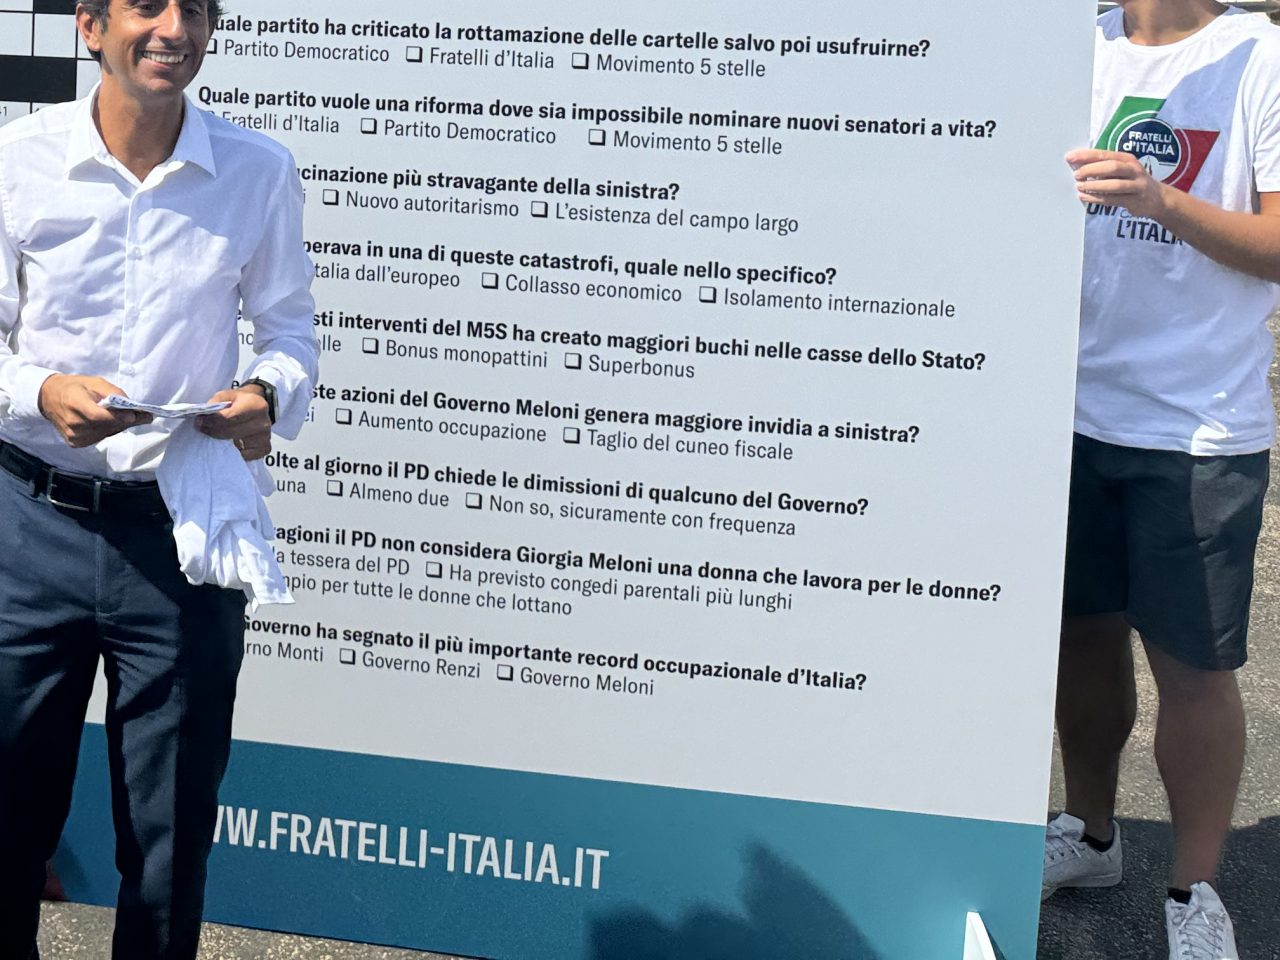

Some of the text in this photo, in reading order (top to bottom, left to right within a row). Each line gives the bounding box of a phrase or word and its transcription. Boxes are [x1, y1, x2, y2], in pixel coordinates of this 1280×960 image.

[214, 14, 930, 57] uale partito ha criticato la rottamazione delle cartelle salvo poi usufruirne?
[225, 39, 765, 77] Partito Democratico Fratelli d'Italia Movimento 5 stelle
[199, 86, 996, 138] Quale partito vuole una riforma dove sia impossibile nominare nuovi senatori a vita?
[1128, 130, 1172, 143] FRATELLI
[1123, 140, 1175, 155] d'ITALIA
[393, 169, 679, 200] più stravagante della sinistra?
[367, 240, 836, 285] in una di queste catastrofi, quale nello specifico?
[356, 264, 955, 317] dall'europeo Collasso economico Isolamento internazionale
[341, 386, 919, 443] azioni del Governo Meloni genera maggiore invidia a sinistra?
[291, 550, 792, 612] tessera del PD Ha previsto congedi parentali più lunghi
[336, 529, 1001, 601] il PD non considera Giorgia Meloni una donna che lavora per le donne?
[317, 622, 866, 690] ha segnato il più importante record occupazionale d'Italia?
[213, 804, 609, 890] W.FRATELLI-ITALIA.IT
